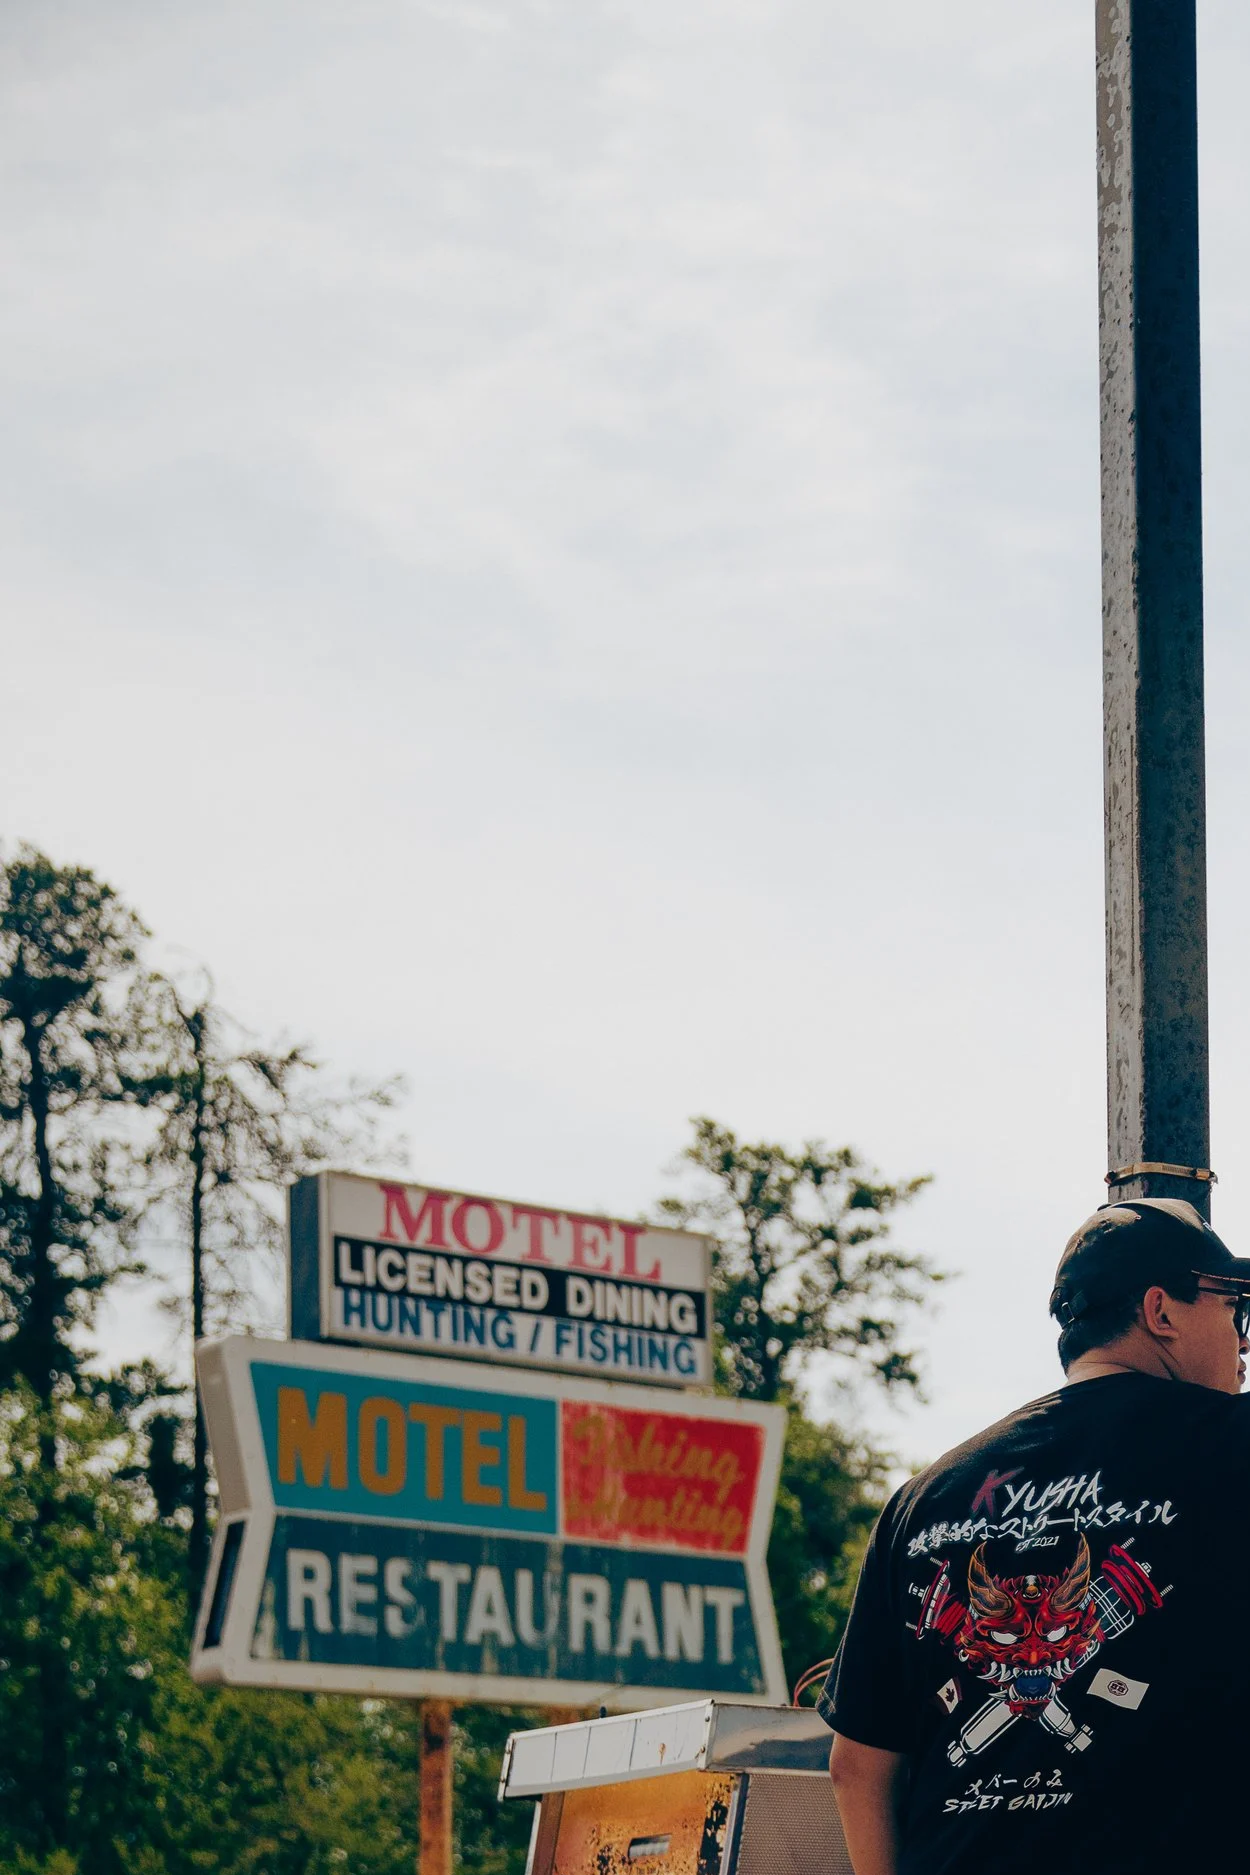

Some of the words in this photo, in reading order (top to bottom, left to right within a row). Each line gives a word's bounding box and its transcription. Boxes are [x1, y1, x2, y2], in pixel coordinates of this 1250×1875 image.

[379, 1182, 661, 1281] MOTEL
[338, 1241, 549, 1311] LICENSED
[565, 1279, 697, 1334] DINING
[342, 1290, 515, 1350] HUNTING
[554, 1322, 696, 1375] FISHING
[276, 1386, 547, 1511] MOTEL
[286, 1548, 746, 1664] RESTAURANT
